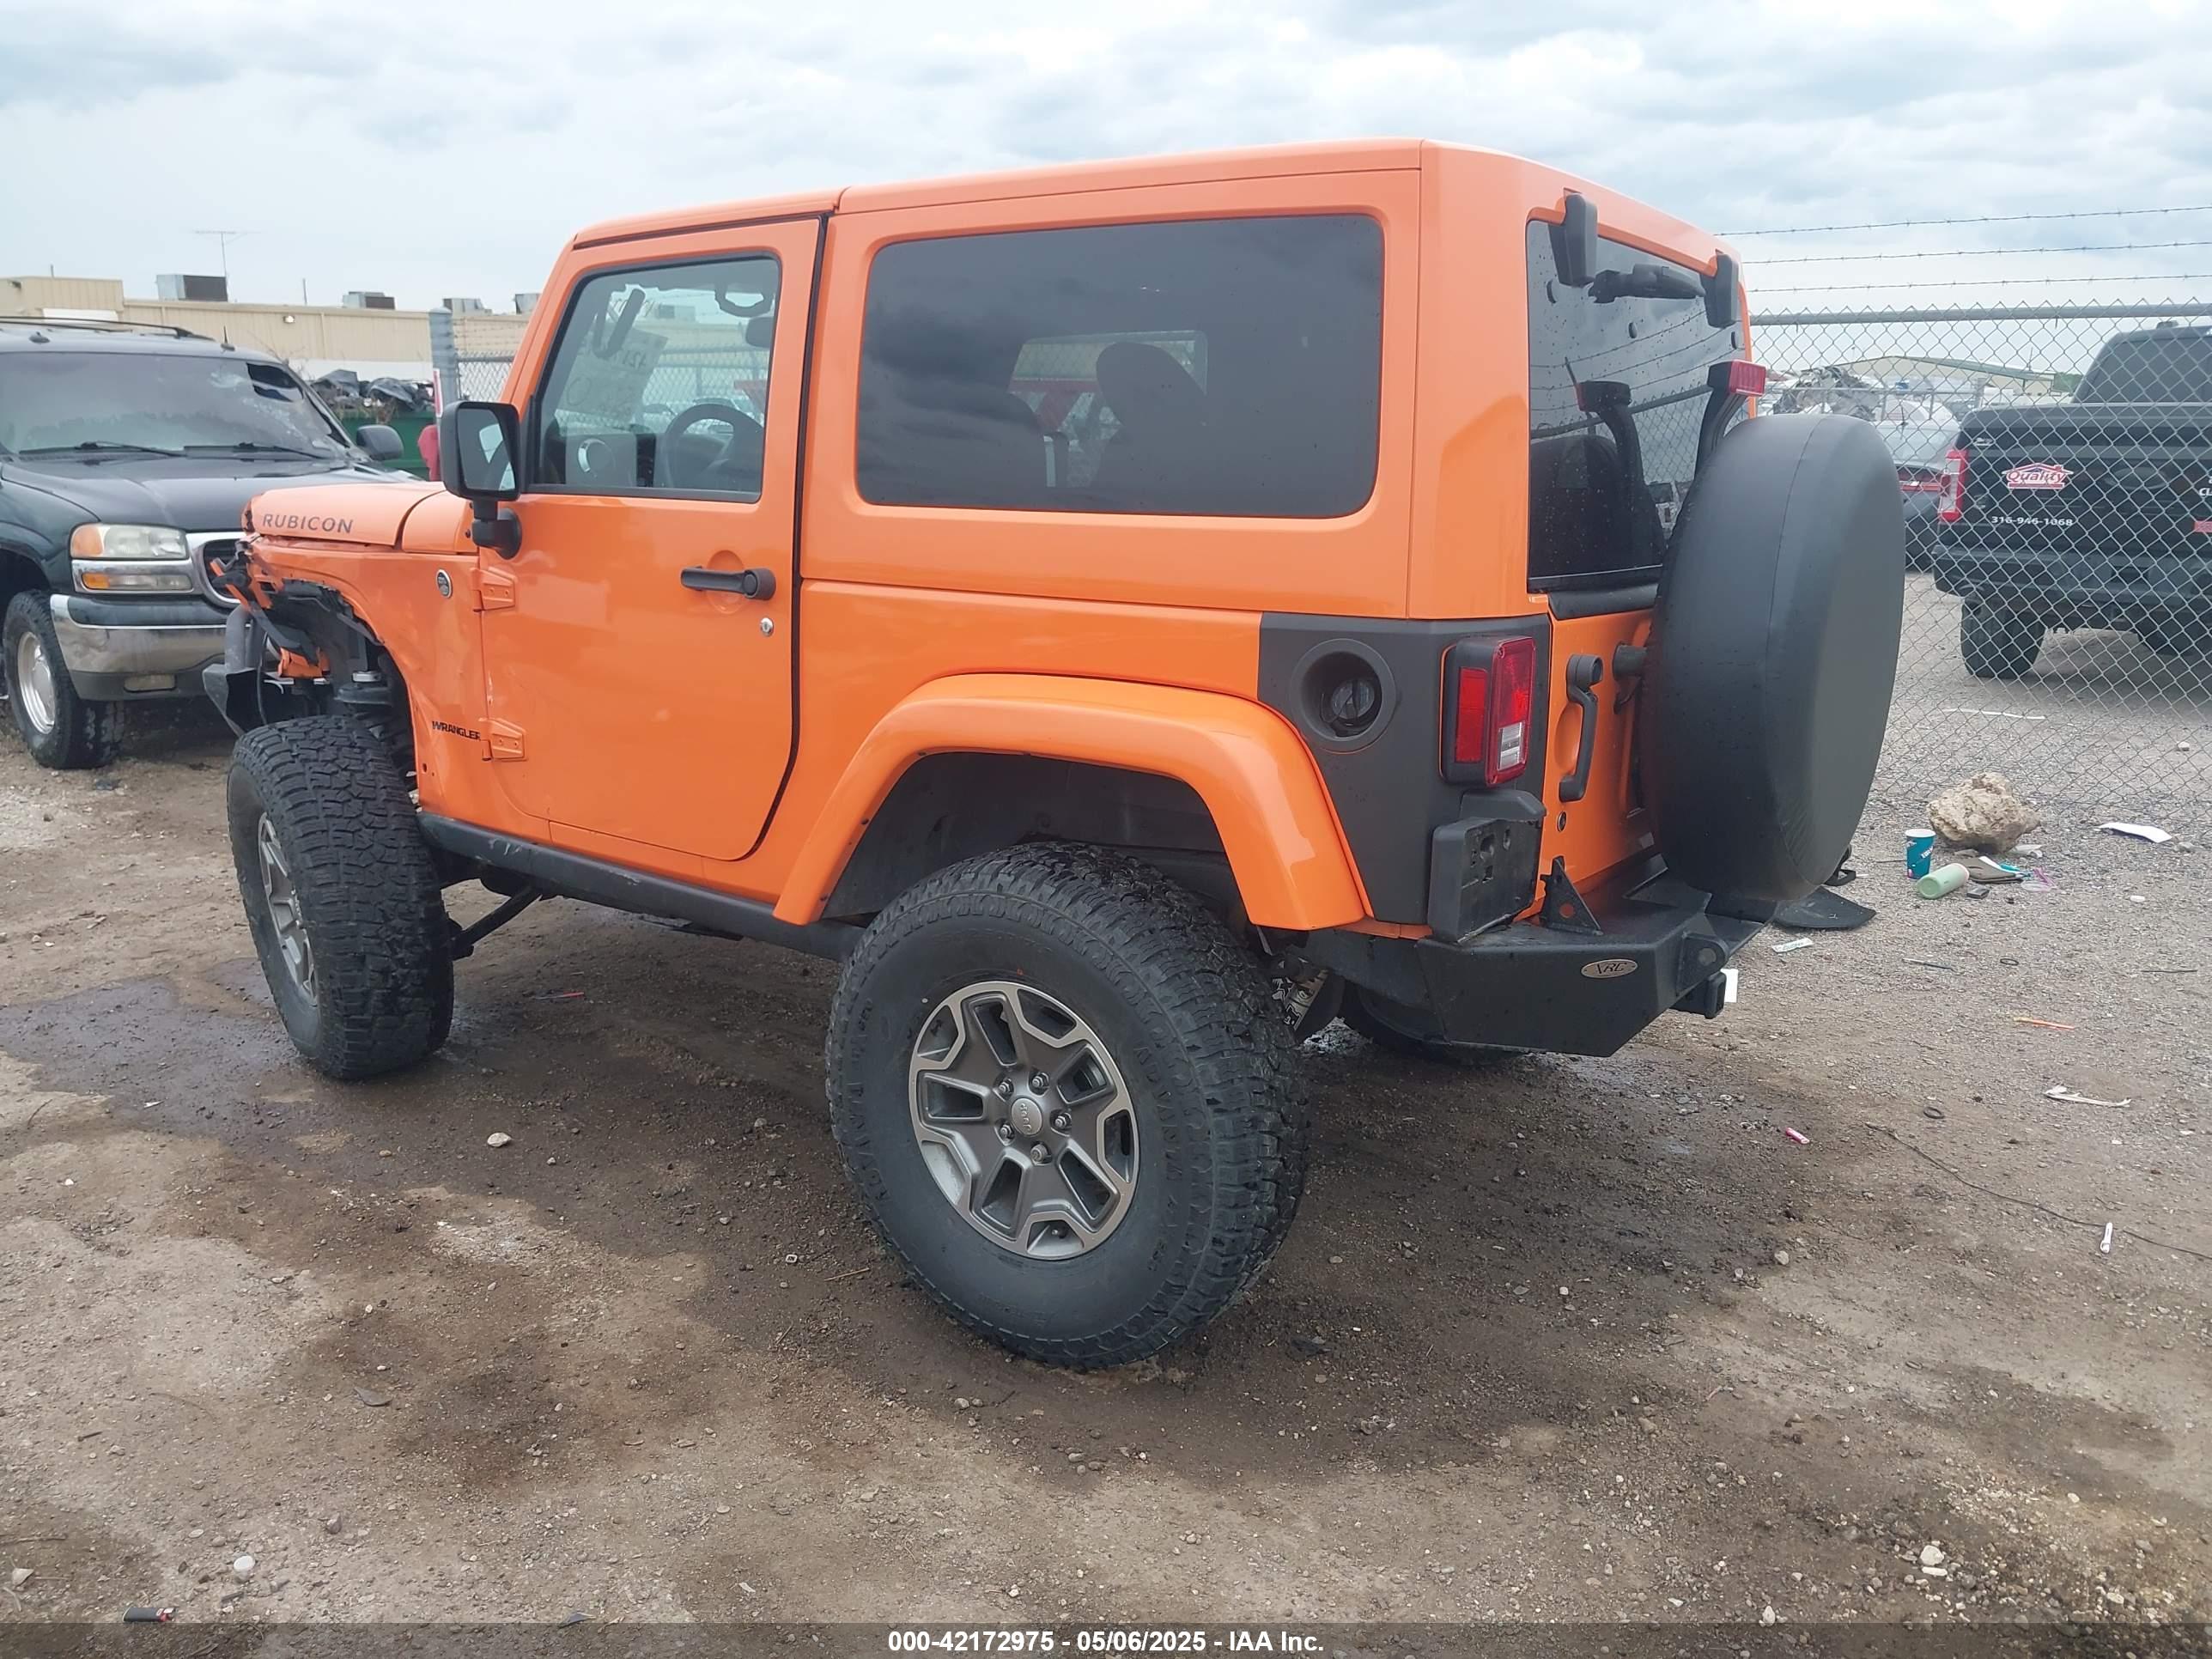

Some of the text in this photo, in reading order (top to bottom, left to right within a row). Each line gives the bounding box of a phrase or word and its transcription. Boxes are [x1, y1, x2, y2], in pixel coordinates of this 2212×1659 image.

[2008, 470, 2066, 483] Quality
[263, 514, 353, 533] RUBICON
[1991, 516, 2074, 526] 316-946-1068
[1020, 1103, 1032, 1132] Jeep
